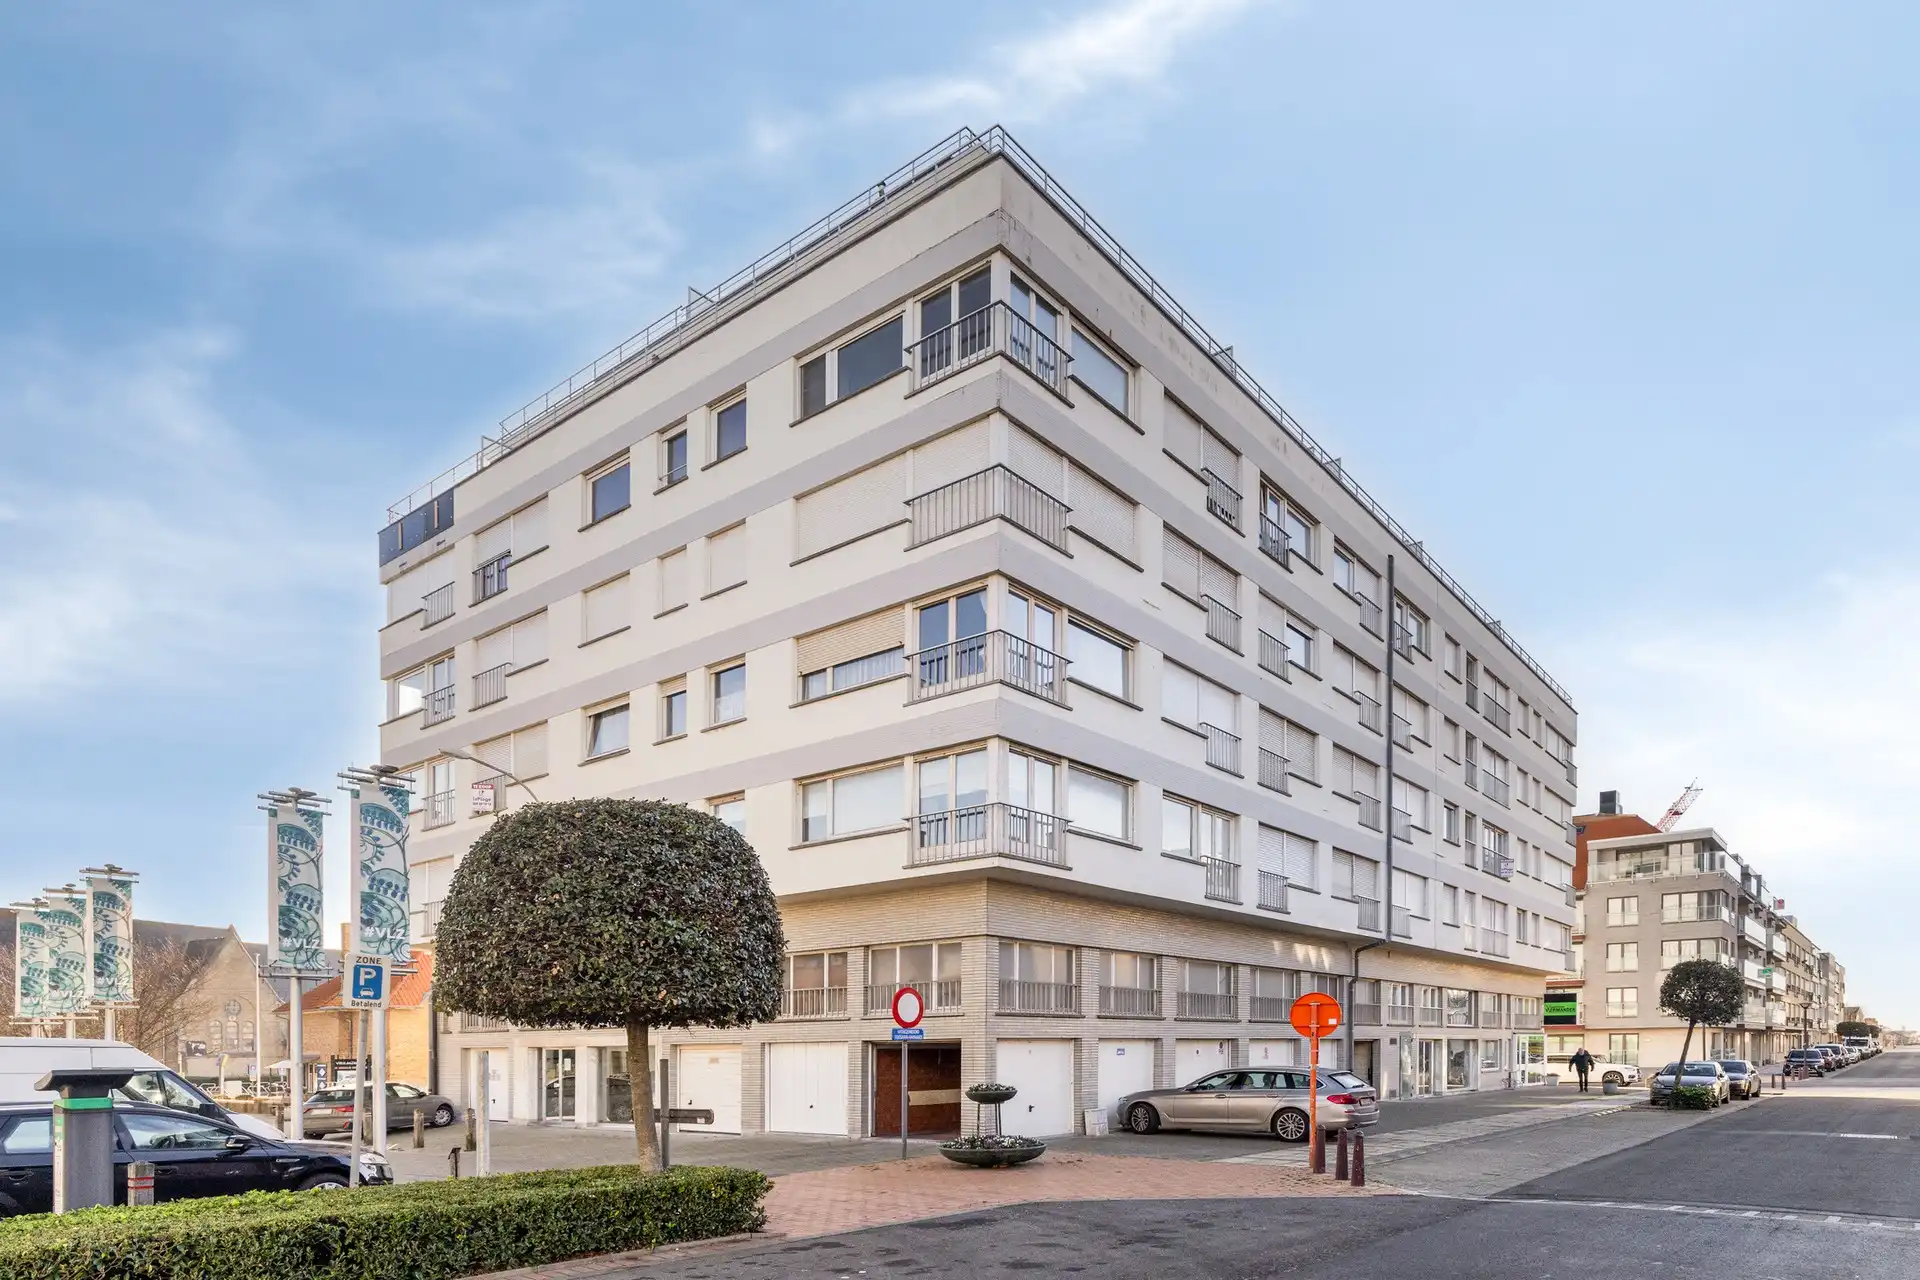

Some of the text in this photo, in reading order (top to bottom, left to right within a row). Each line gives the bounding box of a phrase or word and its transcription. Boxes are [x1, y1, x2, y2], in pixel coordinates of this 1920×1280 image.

[363, 926, 405, 939] #VLZ
[281, 937, 320, 949] #VLZ
[356, 955, 382, 964] ZONE
[96, 977, 129, 986] #VLZ
[360, 967, 376, 986] P
[351, 1000, 382, 1008] Betalend
